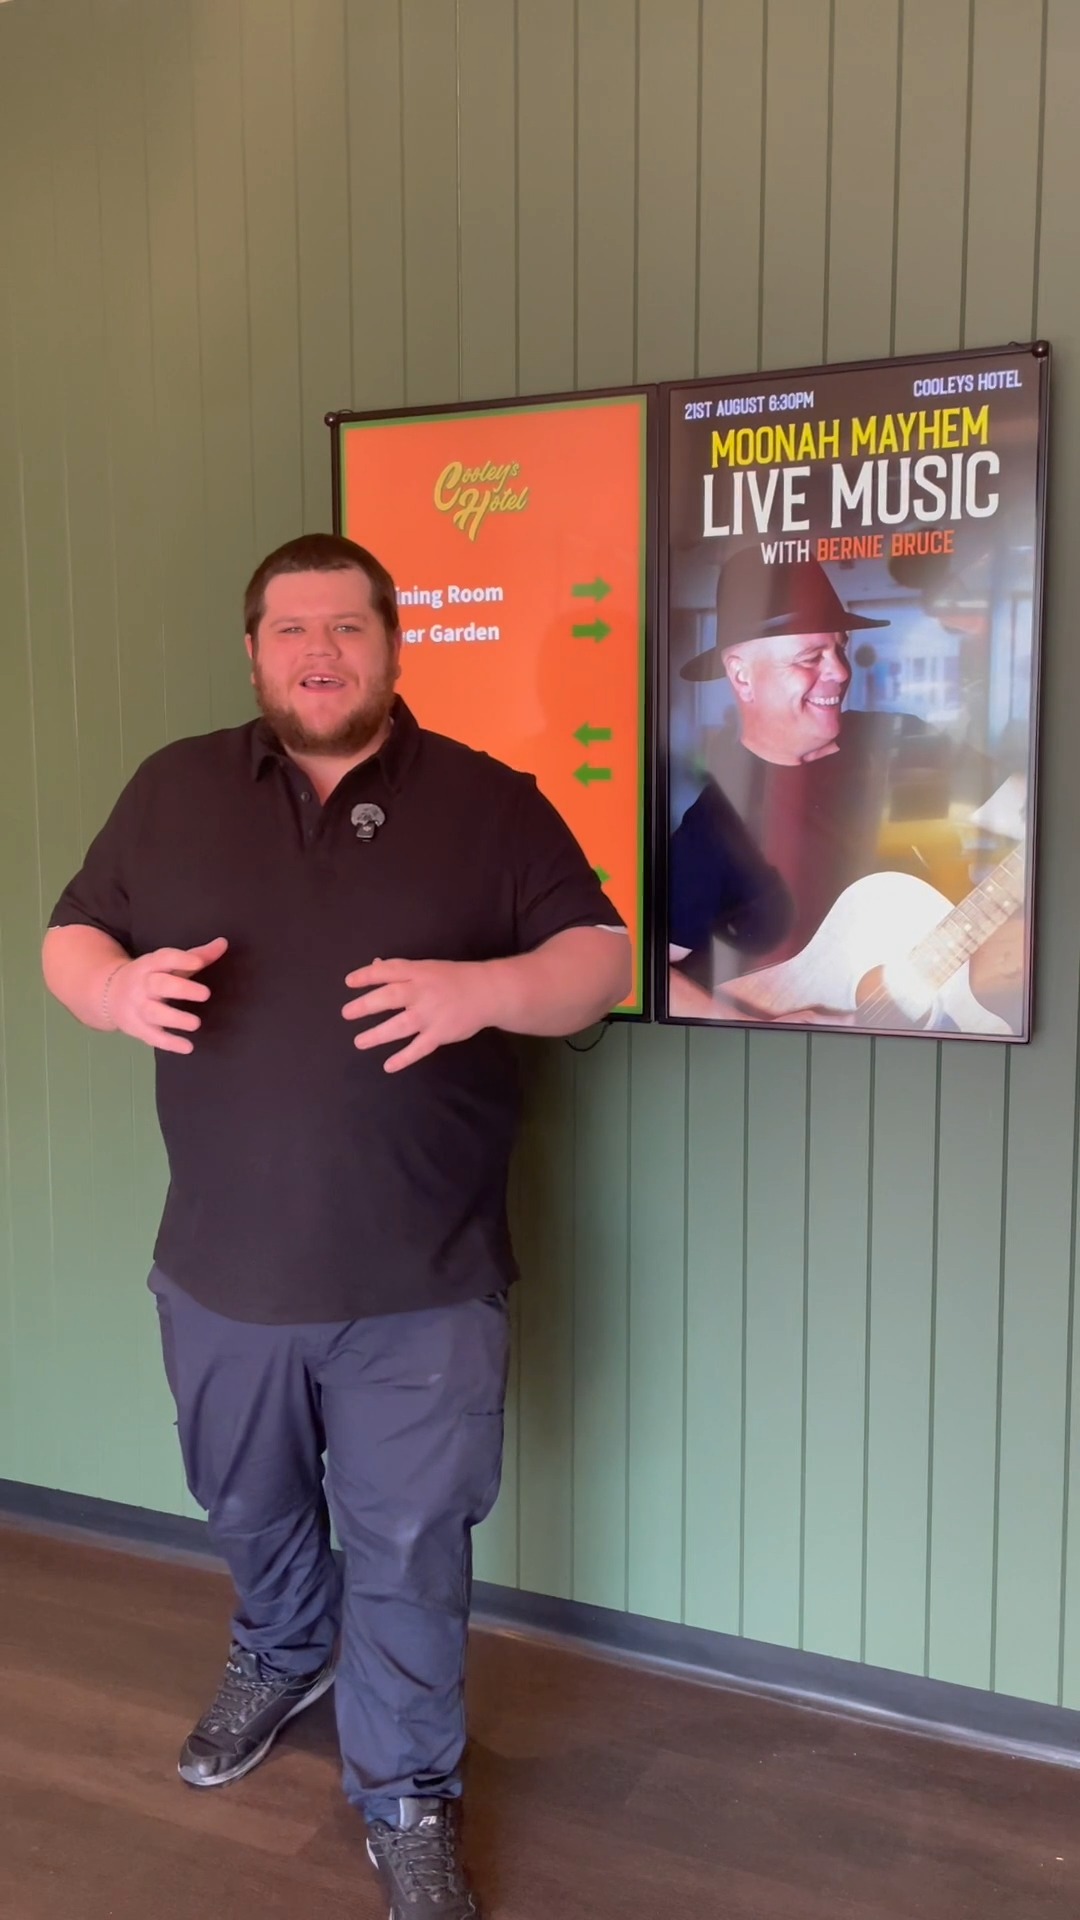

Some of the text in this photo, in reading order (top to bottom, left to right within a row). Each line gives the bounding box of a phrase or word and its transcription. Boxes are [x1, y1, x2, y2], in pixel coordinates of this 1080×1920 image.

[914, 369, 1023, 397] COOLEYS HOTEL
[684, 391, 815, 420] 21ST AUGUST 6:30PM
[711, 404, 990, 469] MOONAH MAYHEM
[433, 460, 520, 512] Cooley's
[702, 450, 1000, 538] LIVE MUSIC
[452, 487, 529, 542] Hotel
[761, 530, 955, 565] WITH BERNIE BRUCE
[395, 584, 504, 609] ining Room
[402, 621, 500, 644] er Garden
